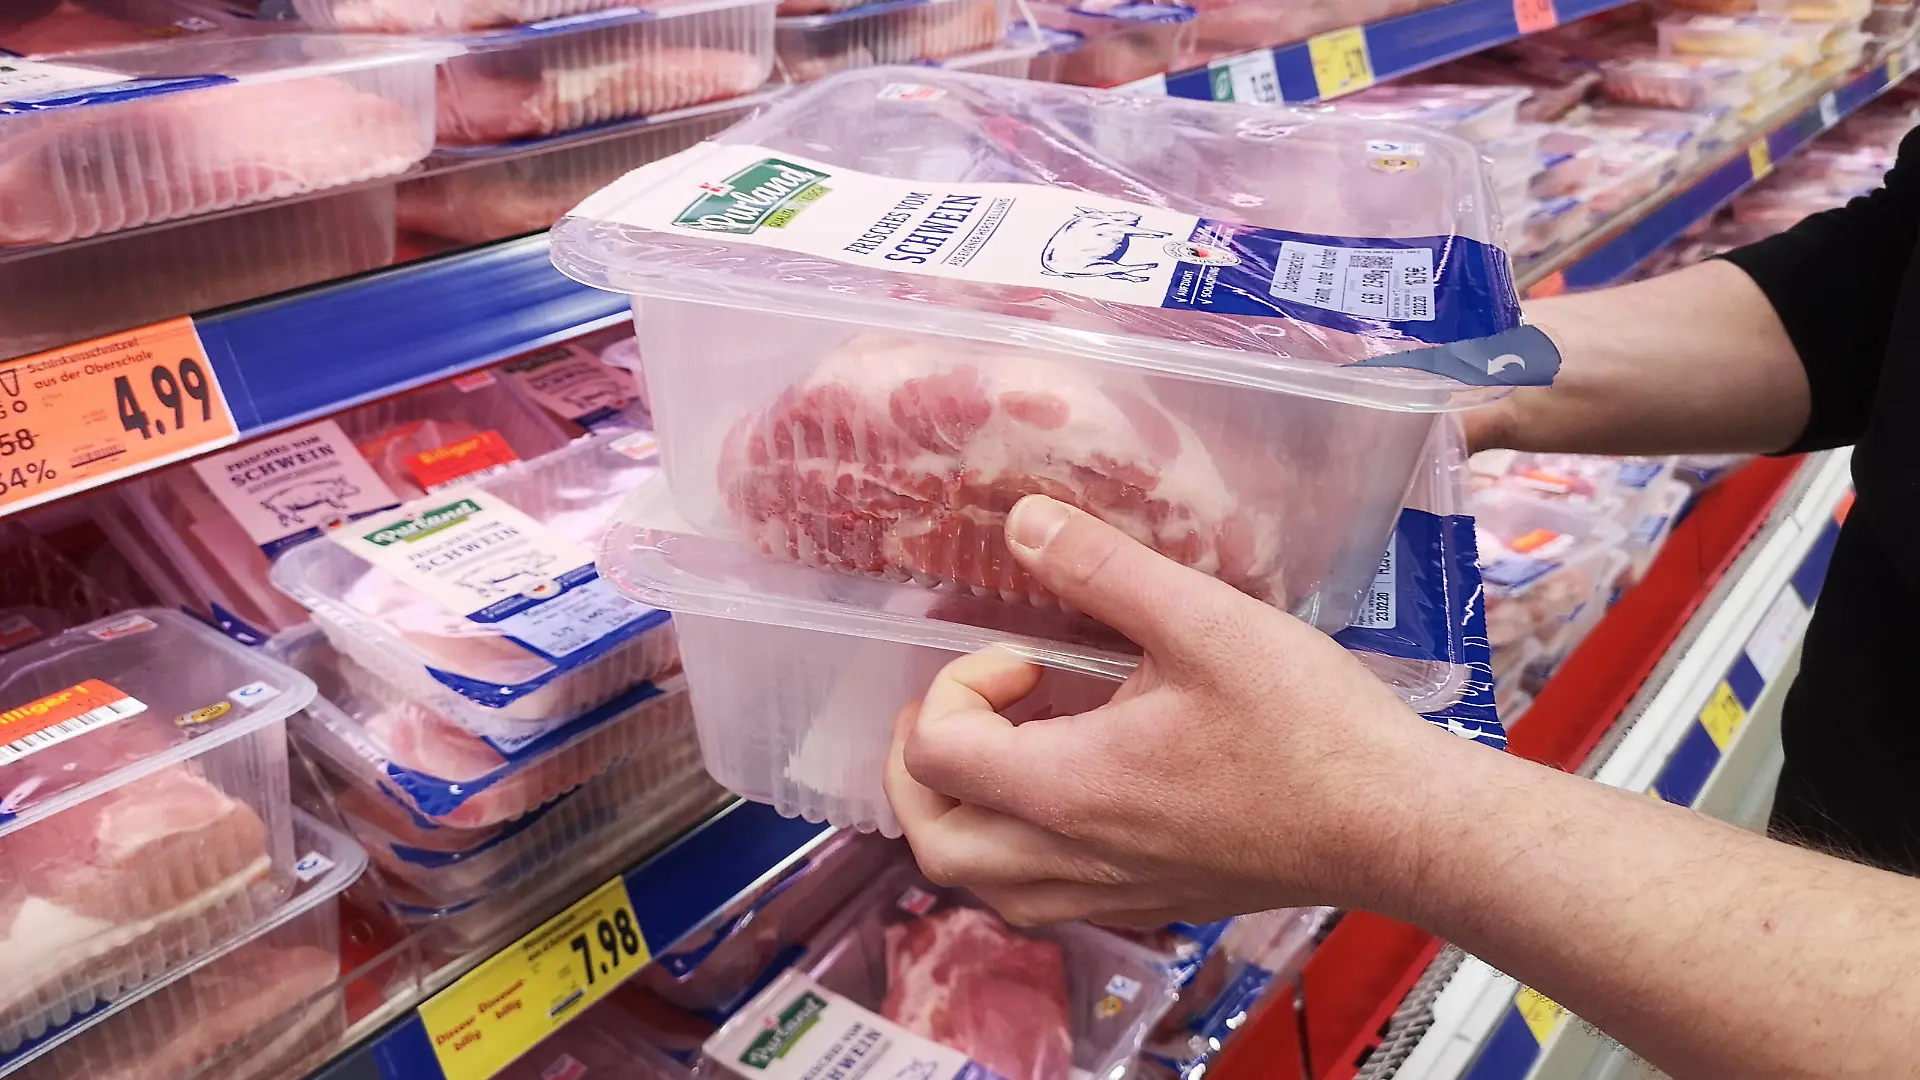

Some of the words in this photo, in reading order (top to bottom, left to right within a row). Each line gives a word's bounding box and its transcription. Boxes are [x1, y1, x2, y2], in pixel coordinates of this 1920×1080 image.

[692, 164, 817, 230] Purland
[843, 211, 912, 255] FRISCHES
[895, 191, 932, 212] VOM
[884, 194, 982, 265] SCHWEIN
[34, 378, 58, 389] aus
[60, 370, 81, 383] der
[84, 350, 153, 376] Oberschale
[113, 357, 212, 440] 4.99
[230, 444, 337, 488] SCHWEIN
[415, 526, 521, 573] SCHWEIN
[570, 907, 639, 985] 7.98
